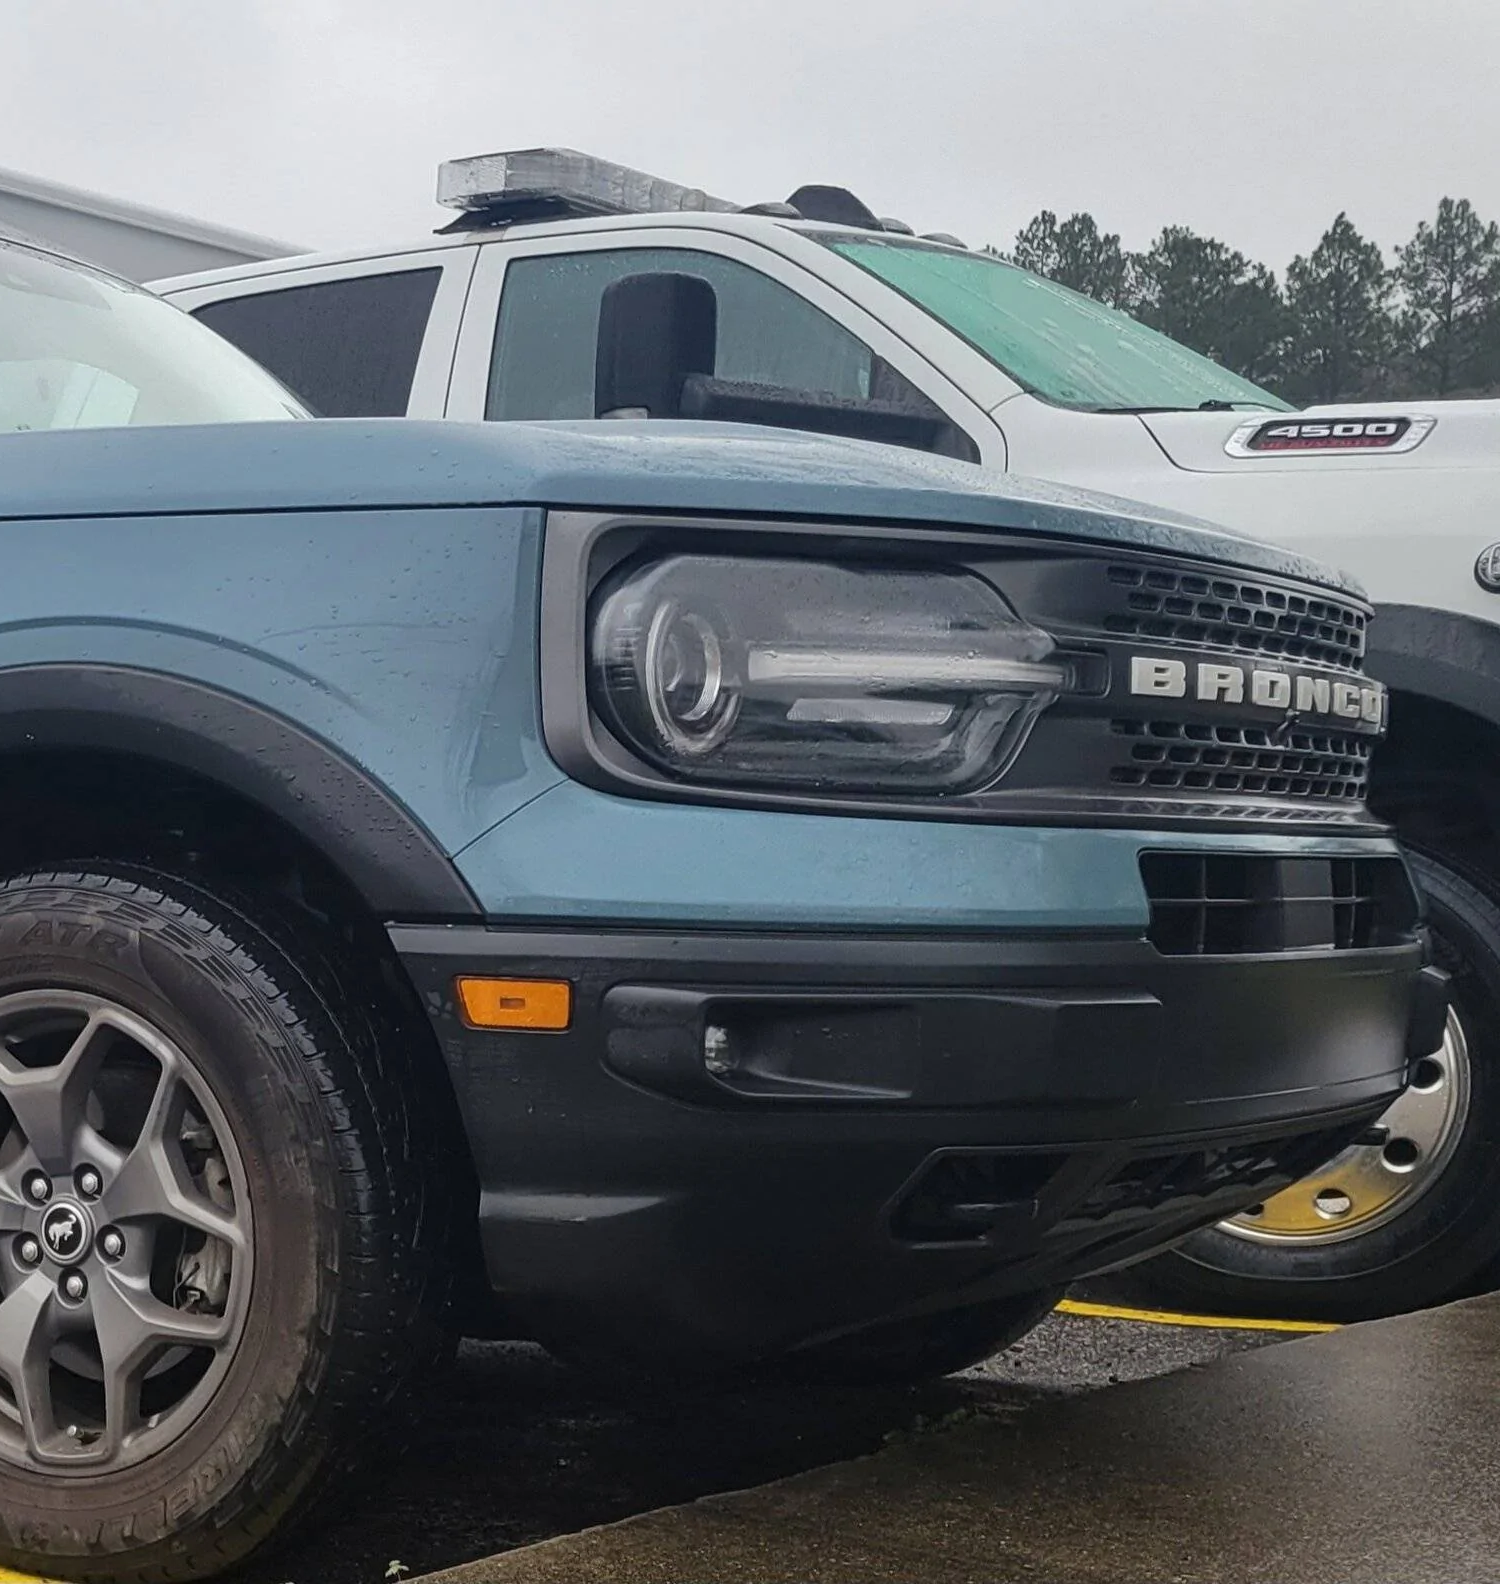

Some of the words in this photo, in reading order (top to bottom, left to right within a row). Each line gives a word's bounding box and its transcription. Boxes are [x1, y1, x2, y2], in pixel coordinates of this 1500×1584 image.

[1267, 423, 1398, 438] 4500
[1131, 656, 1381, 723] BRONCO
[19, 919, 130, 958] ATR
